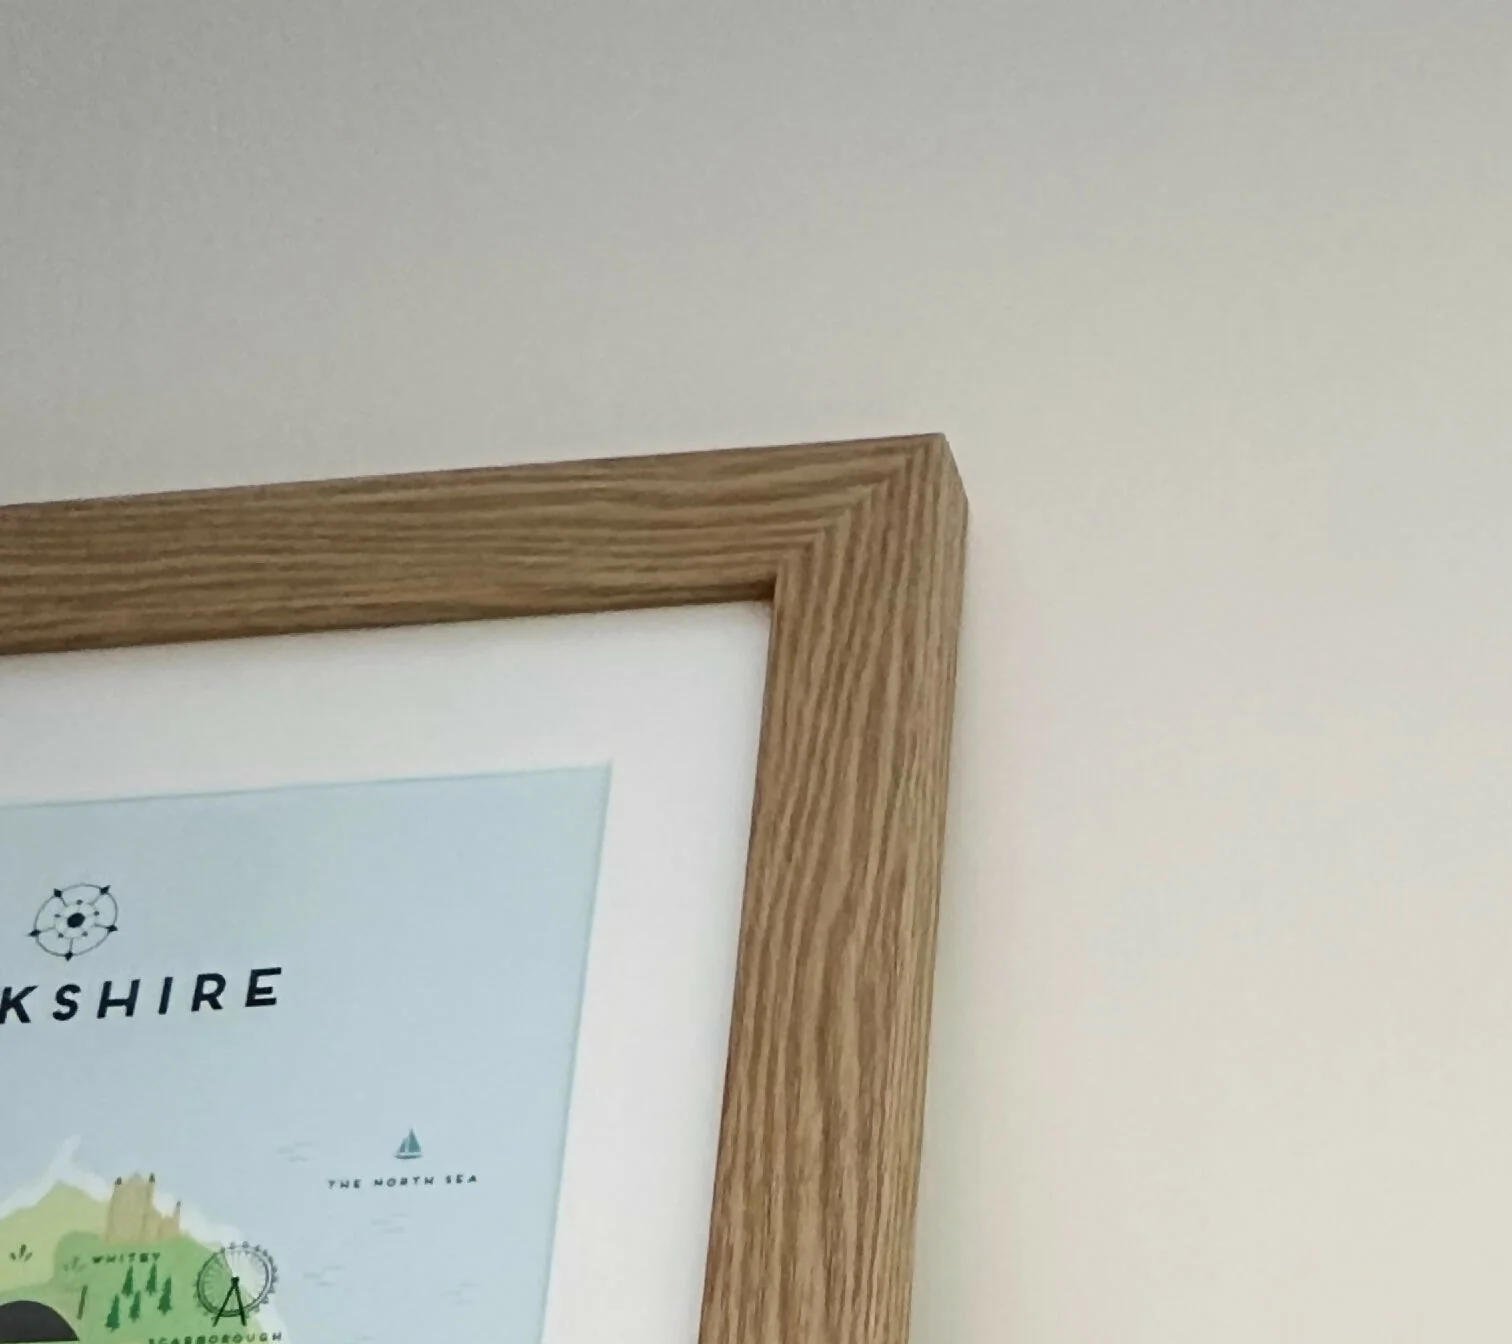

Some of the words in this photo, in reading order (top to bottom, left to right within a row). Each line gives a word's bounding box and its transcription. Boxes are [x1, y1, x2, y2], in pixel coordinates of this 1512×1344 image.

[328, 1178, 361, 1189] THE
[374, 1176, 434, 1187] NORTH
[446, 1174, 477, 1184] SEA
